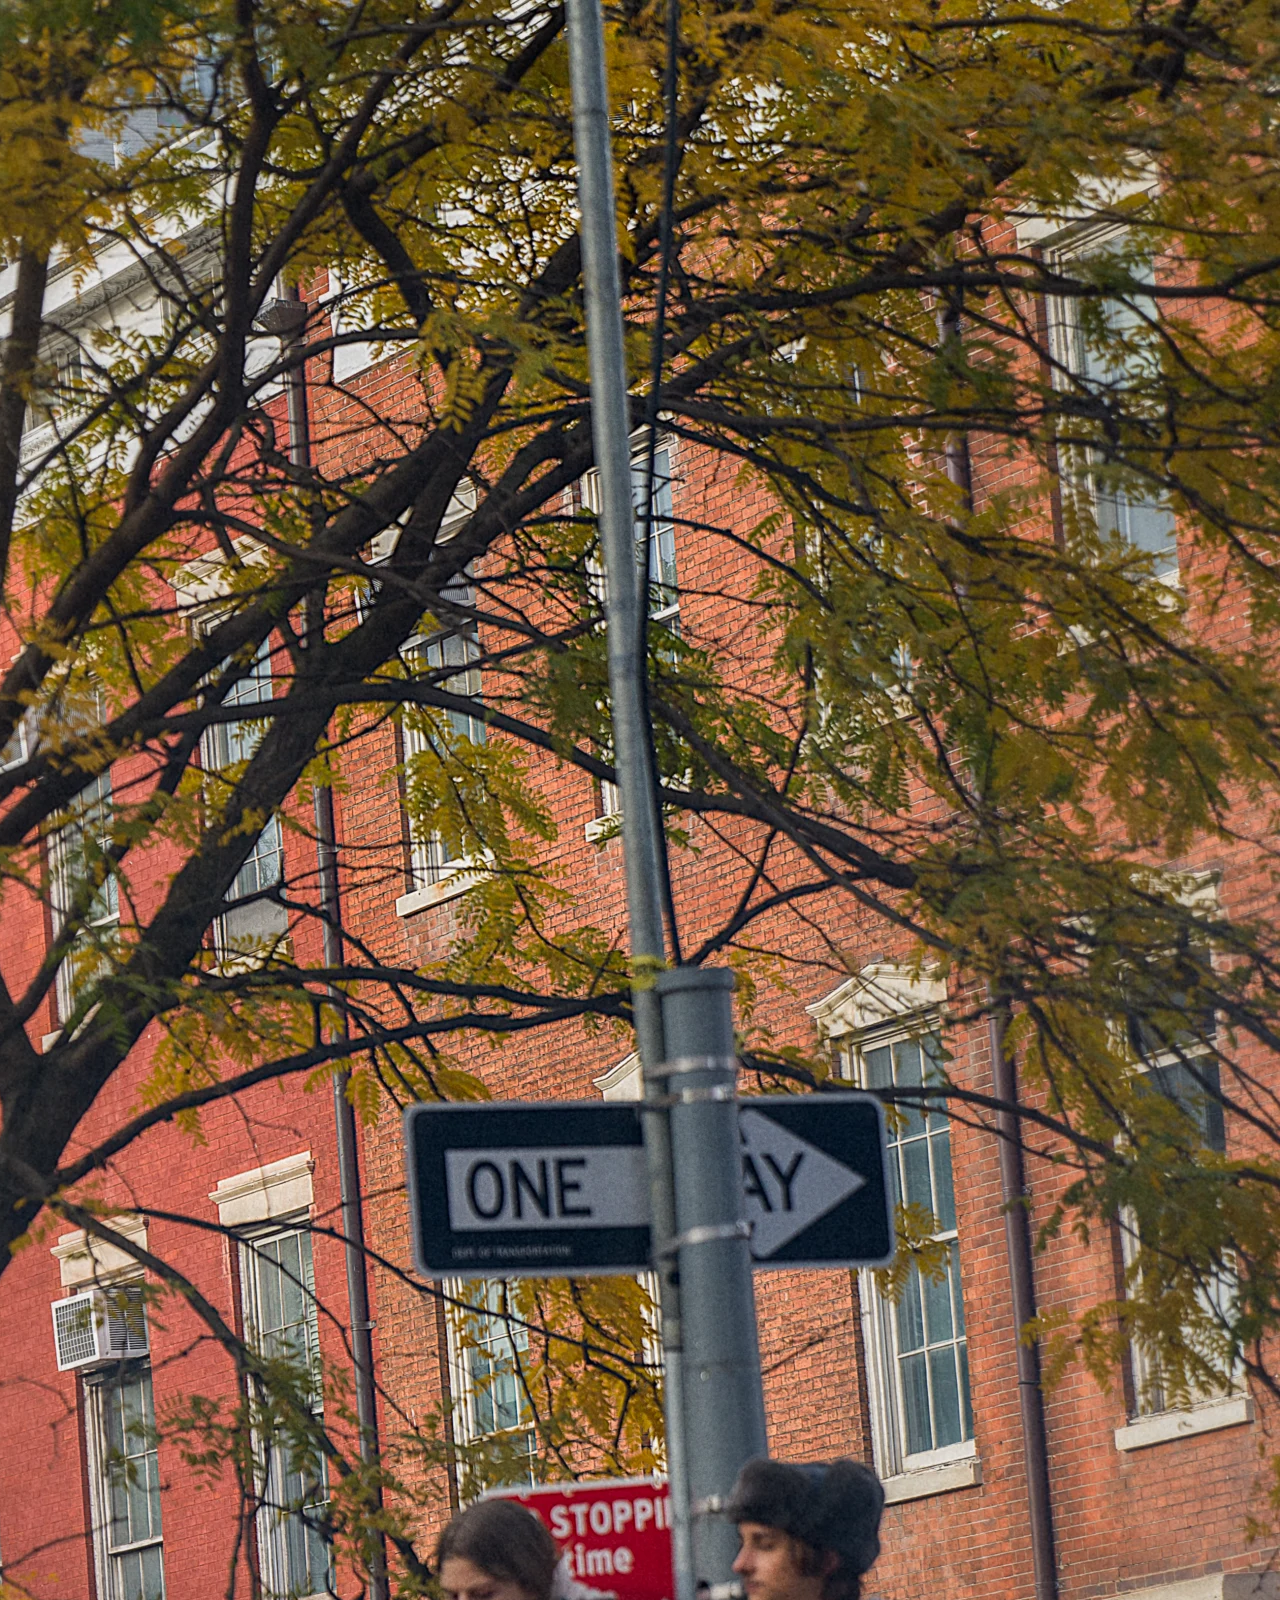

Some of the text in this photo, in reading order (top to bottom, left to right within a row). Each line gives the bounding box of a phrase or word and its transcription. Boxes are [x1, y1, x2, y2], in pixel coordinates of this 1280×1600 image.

[466, 1151, 805, 1221] ONE AY
[550, 1496, 673, 1539] STOPPI
